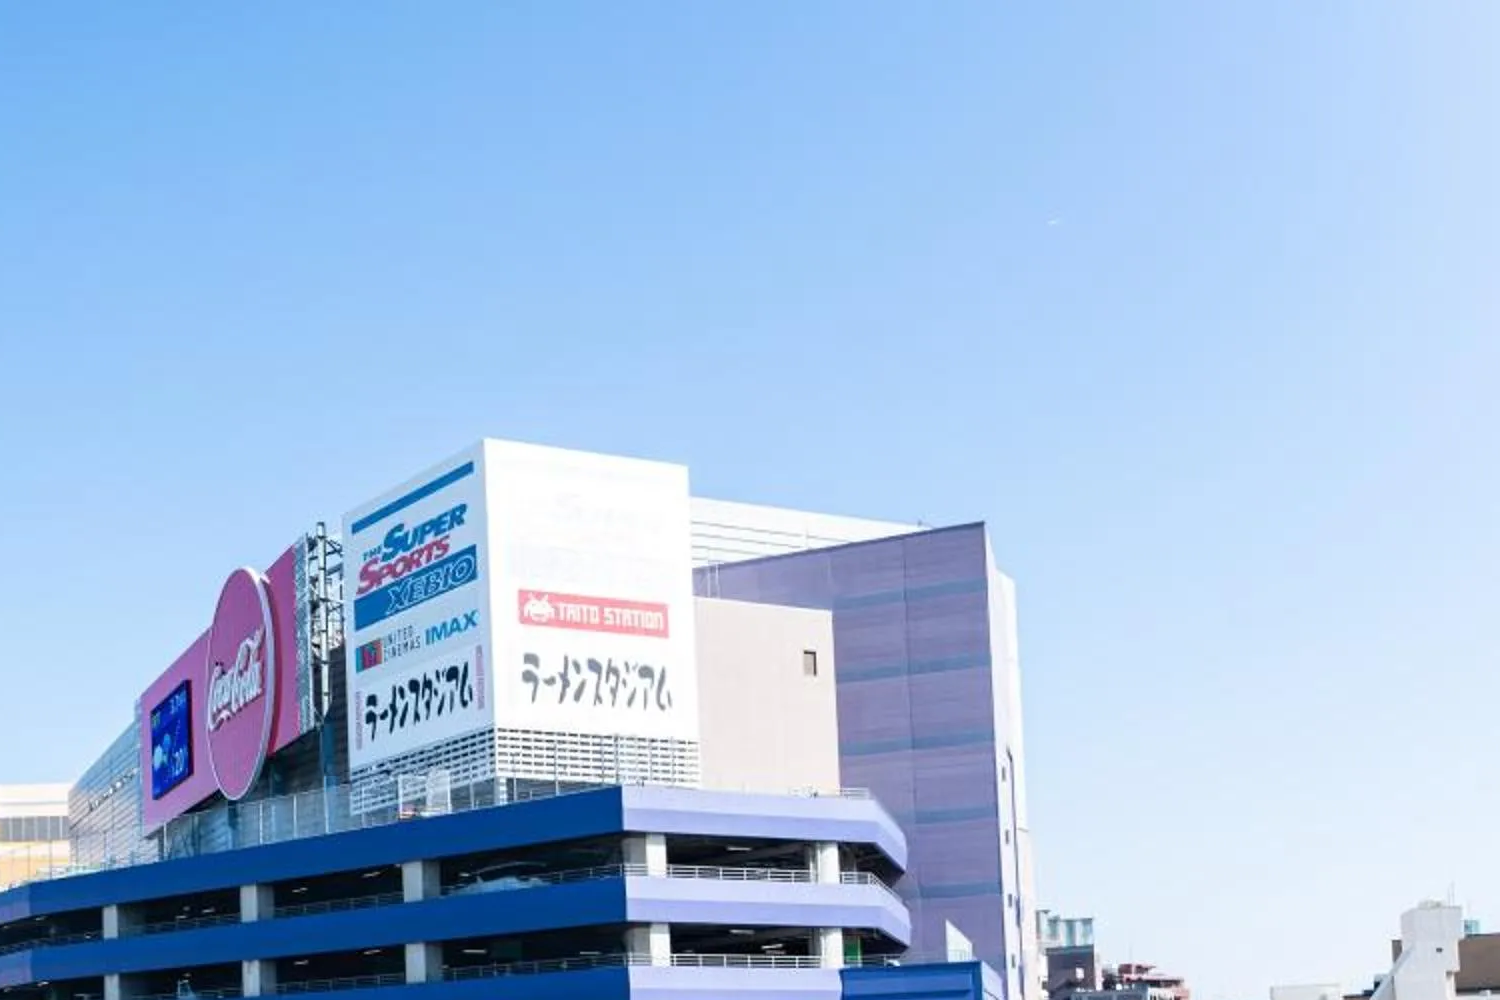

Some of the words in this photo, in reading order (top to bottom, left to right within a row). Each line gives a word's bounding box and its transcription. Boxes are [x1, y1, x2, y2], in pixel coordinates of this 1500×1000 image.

[383, 503, 467, 561] SUPER
[357, 535, 450, 595] SPORTS
[386, 554, 476, 615] XEBIO
[424, 608, 479, 646] IMAX
[558, 602, 600, 626] TAITO
[603, 606, 664, 632] STATION
[365, 661, 473, 742] ラーメンスタジアム
[521, 652, 673, 712] ラーメンスタジアム
